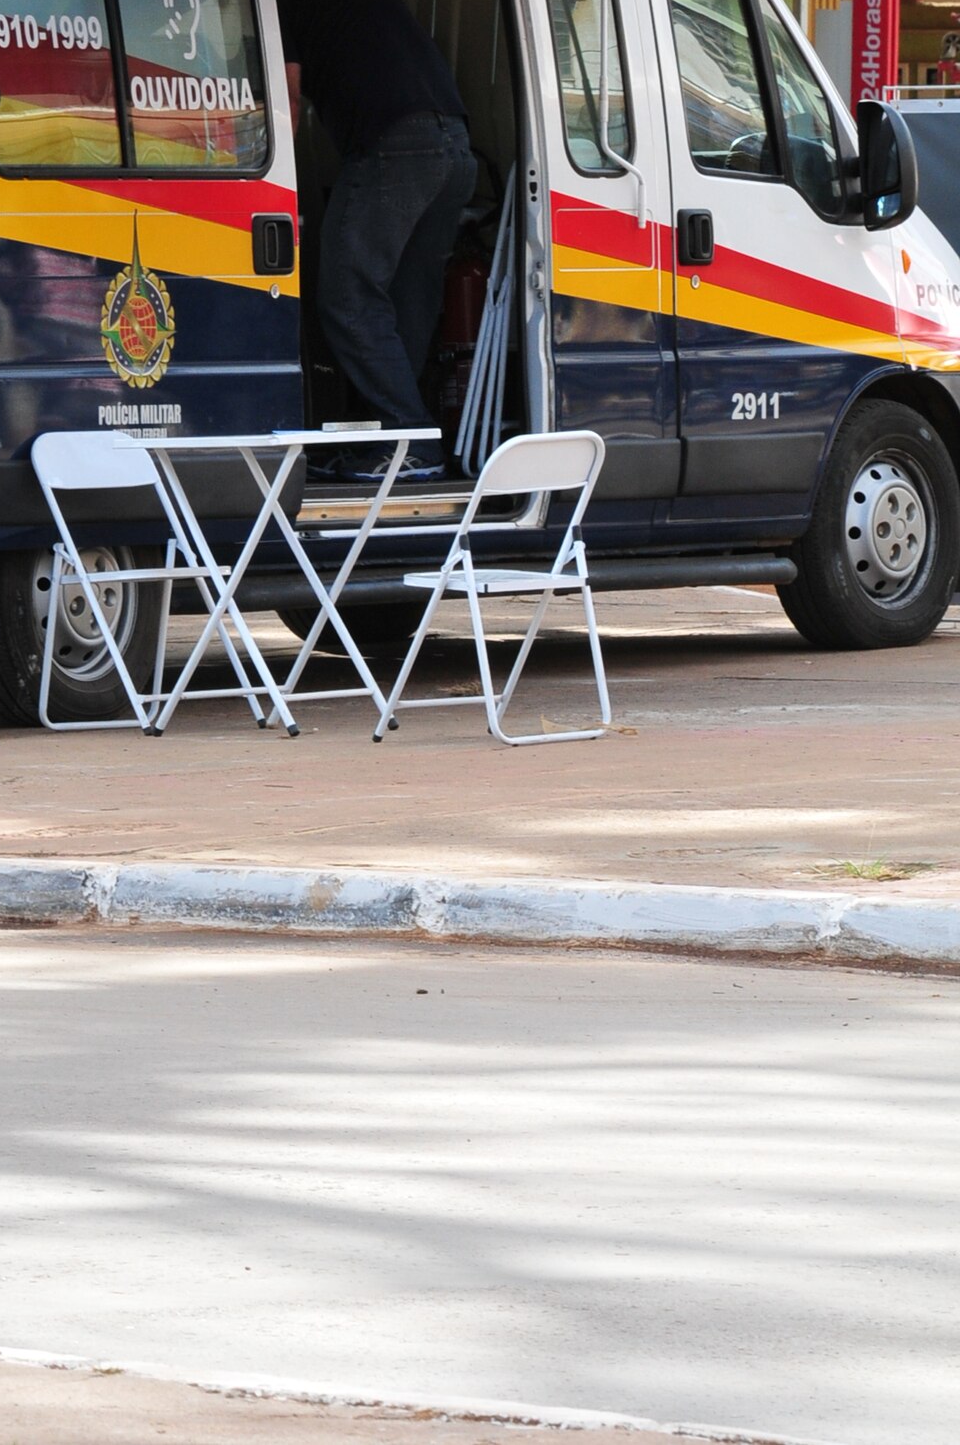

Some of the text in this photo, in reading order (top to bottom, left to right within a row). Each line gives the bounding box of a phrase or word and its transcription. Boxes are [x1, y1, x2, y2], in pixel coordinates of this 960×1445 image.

[130, 75, 257, 111] OUVIDORIA
[98, 401, 182, 426] POLÍCIA MILITAR
[731, 391, 780, 421] 2911
